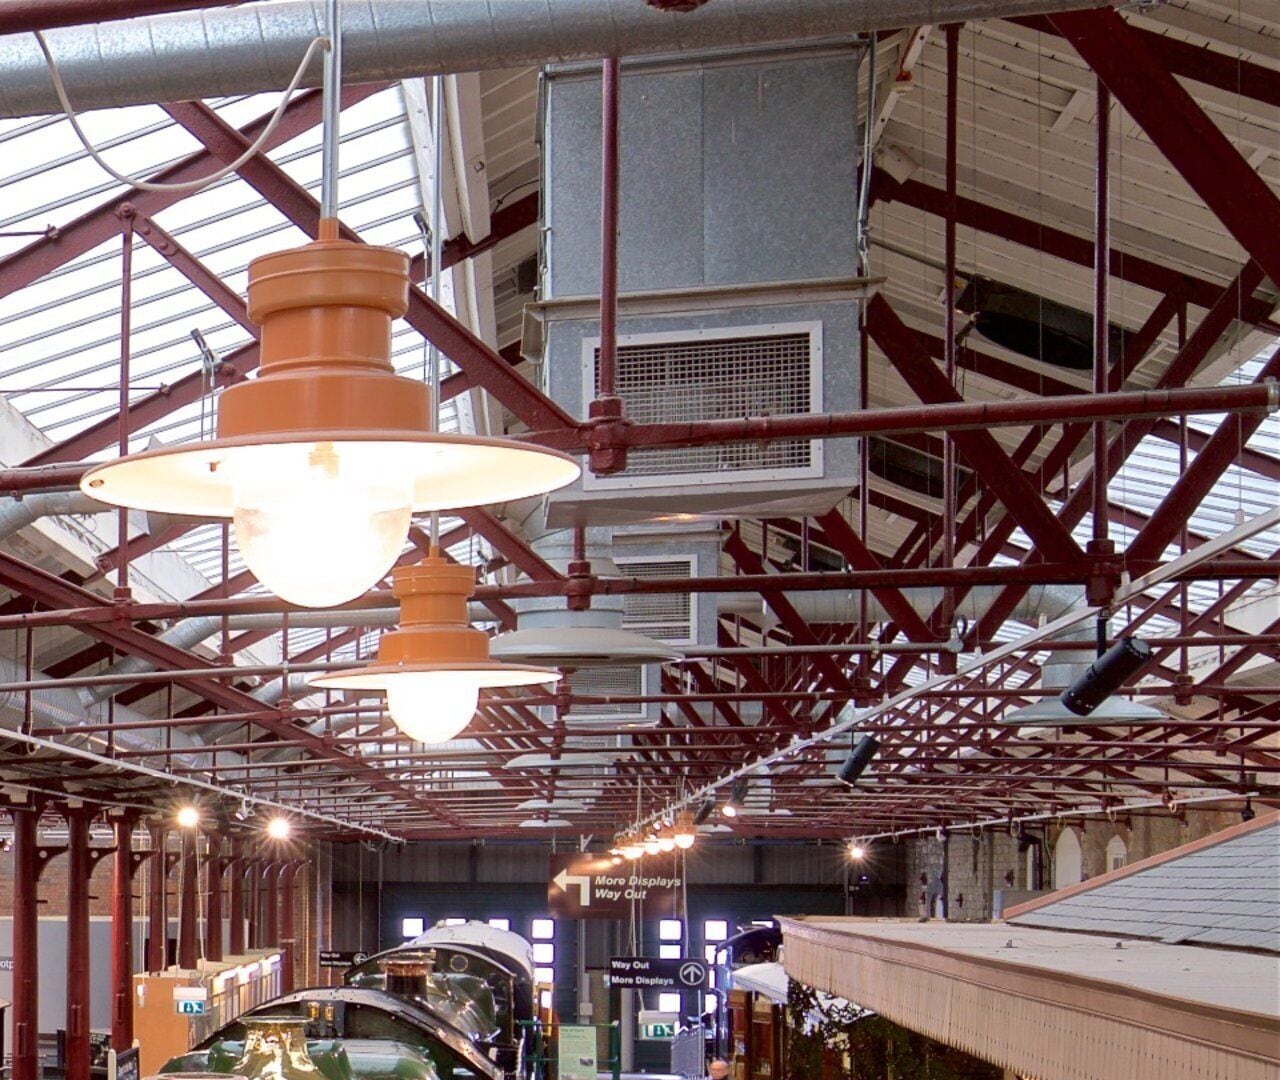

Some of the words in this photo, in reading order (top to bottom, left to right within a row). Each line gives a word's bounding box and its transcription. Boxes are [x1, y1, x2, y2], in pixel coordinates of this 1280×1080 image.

[595, 875, 626, 886] More
[628, 876, 681, 888] Displays
[595, 889, 621, 901] Way
[624, 890, 647, 900] Out
[611, 961, 631, 971] Way
[632, 961, 650, 969] Out
[611, 976, 634, 984] More
[635, 976, 674, 986] Displays
